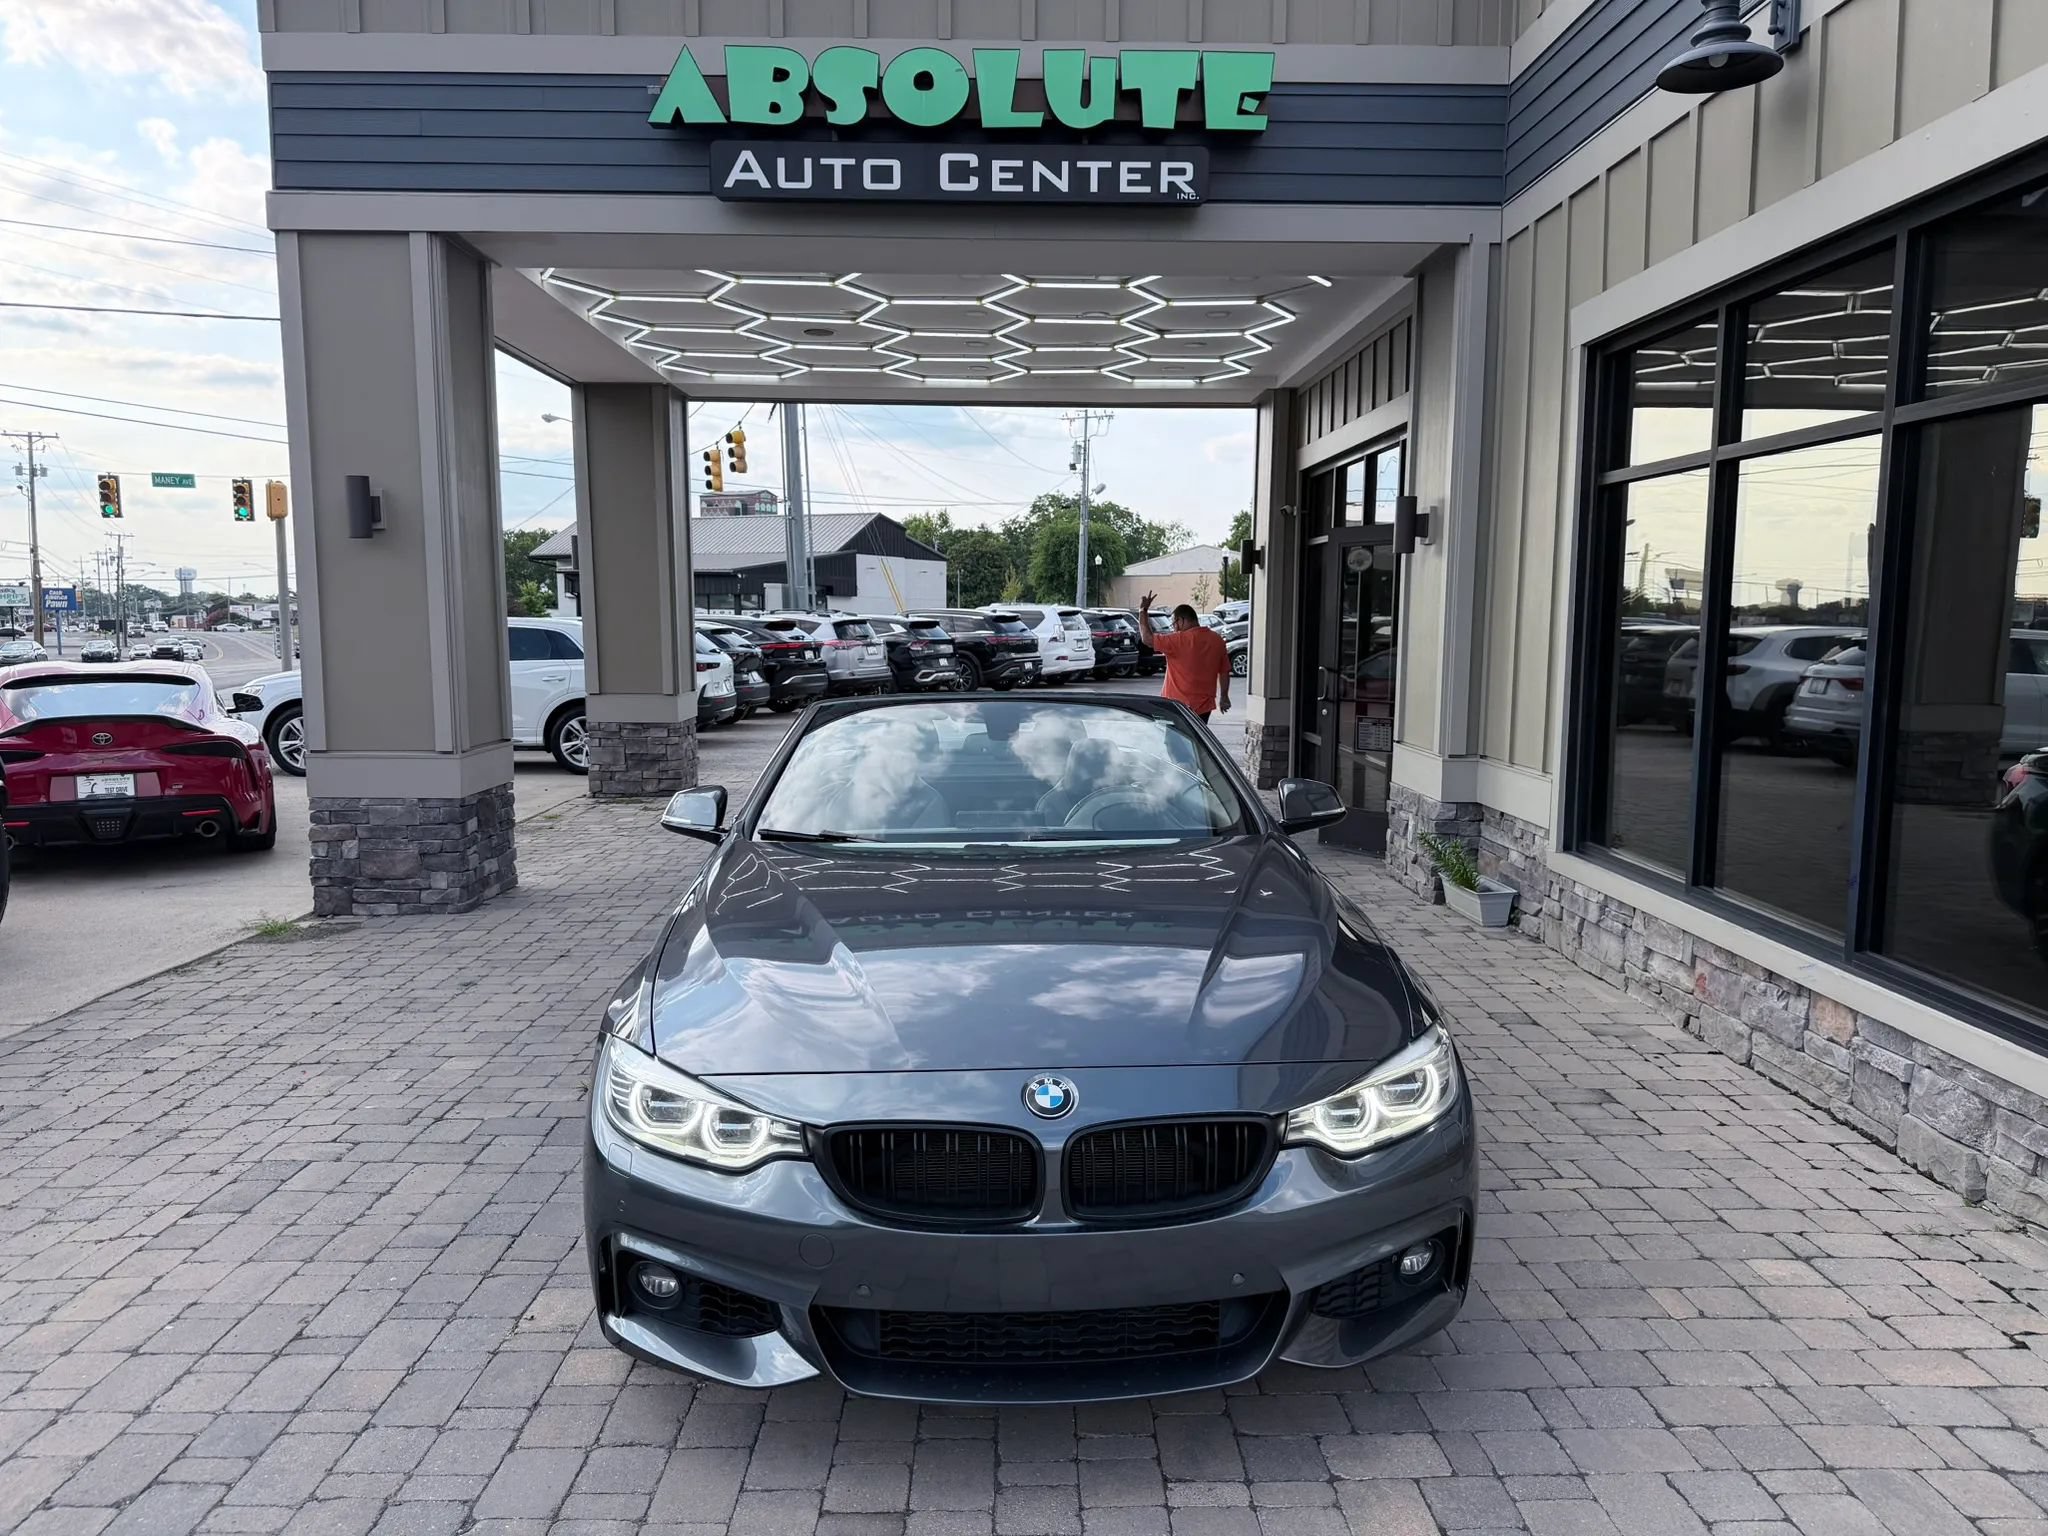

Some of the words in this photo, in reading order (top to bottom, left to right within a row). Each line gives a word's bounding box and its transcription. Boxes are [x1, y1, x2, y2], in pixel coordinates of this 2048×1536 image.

[647, 44, 1275, 131] ABSOLUTE
[155, 476, 179, 485] MANEY
[1030, 1078, 1068, 1090] BMW
